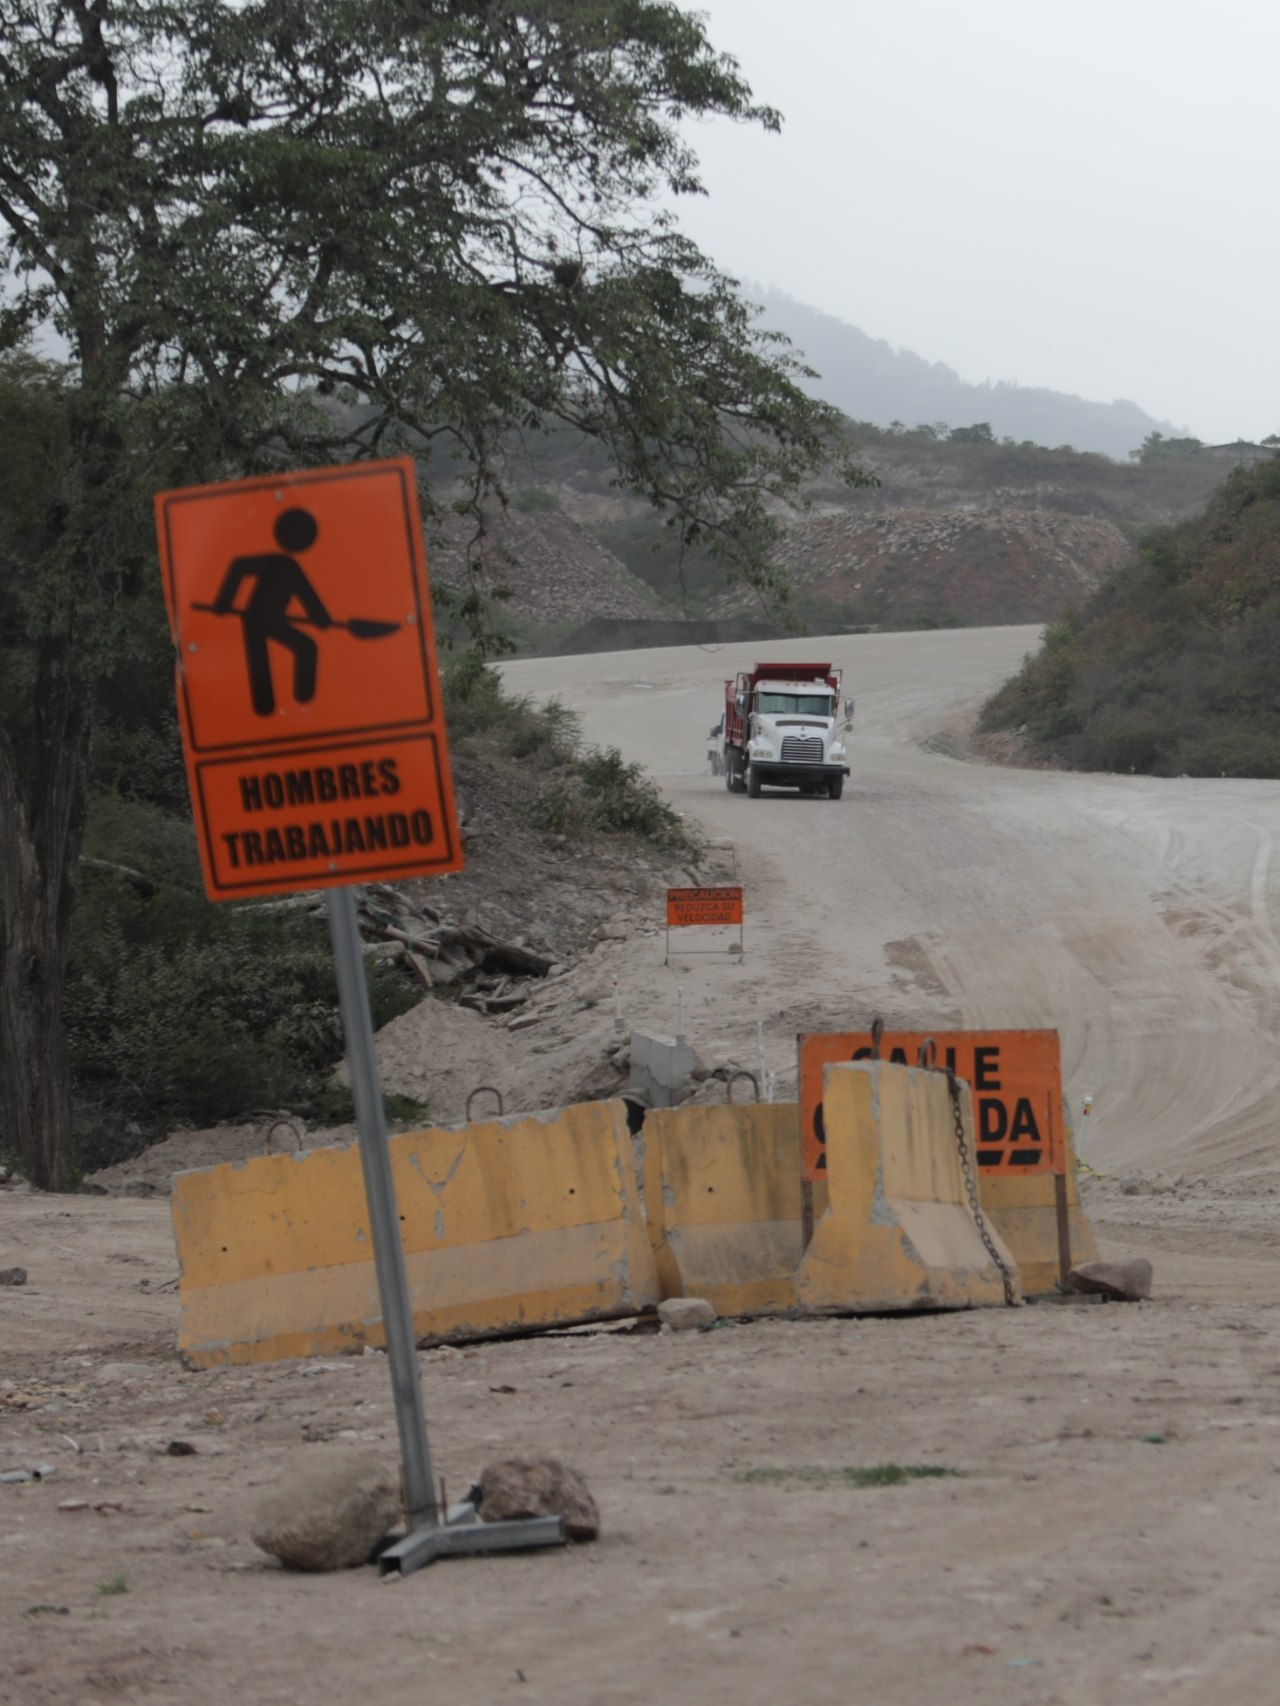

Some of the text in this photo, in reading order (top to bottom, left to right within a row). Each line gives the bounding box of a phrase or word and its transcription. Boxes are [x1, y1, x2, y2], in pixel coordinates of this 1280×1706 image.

[239, 758, 401, 812] HOMBRES
[221, 809, 434, 869] TRABAJANDO
[674, 902, 735, 912] REDUZCA SU
[677, 912, 731, 922] VELOCIDAD
